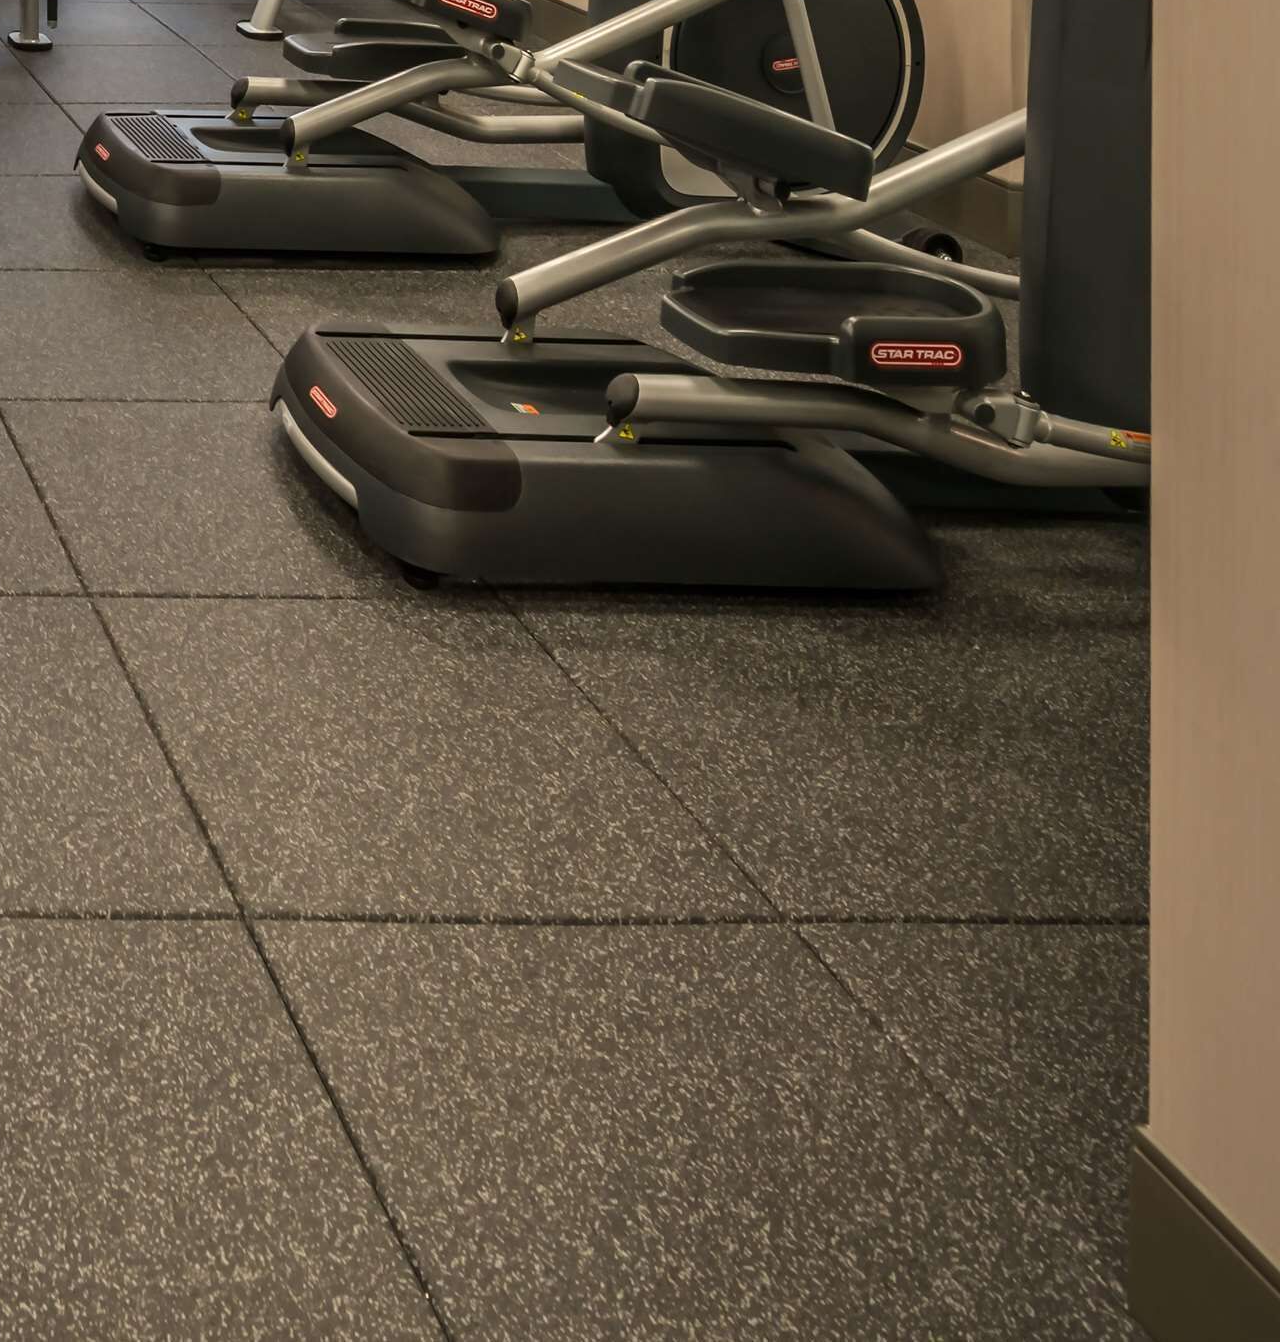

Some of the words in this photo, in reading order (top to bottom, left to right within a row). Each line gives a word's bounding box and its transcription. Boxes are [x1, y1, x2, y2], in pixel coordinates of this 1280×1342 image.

[467, 0, 493, 14] TRAC
[877, 349, 914, 360] STAR
[915, 349, 955, 360] TRAC
